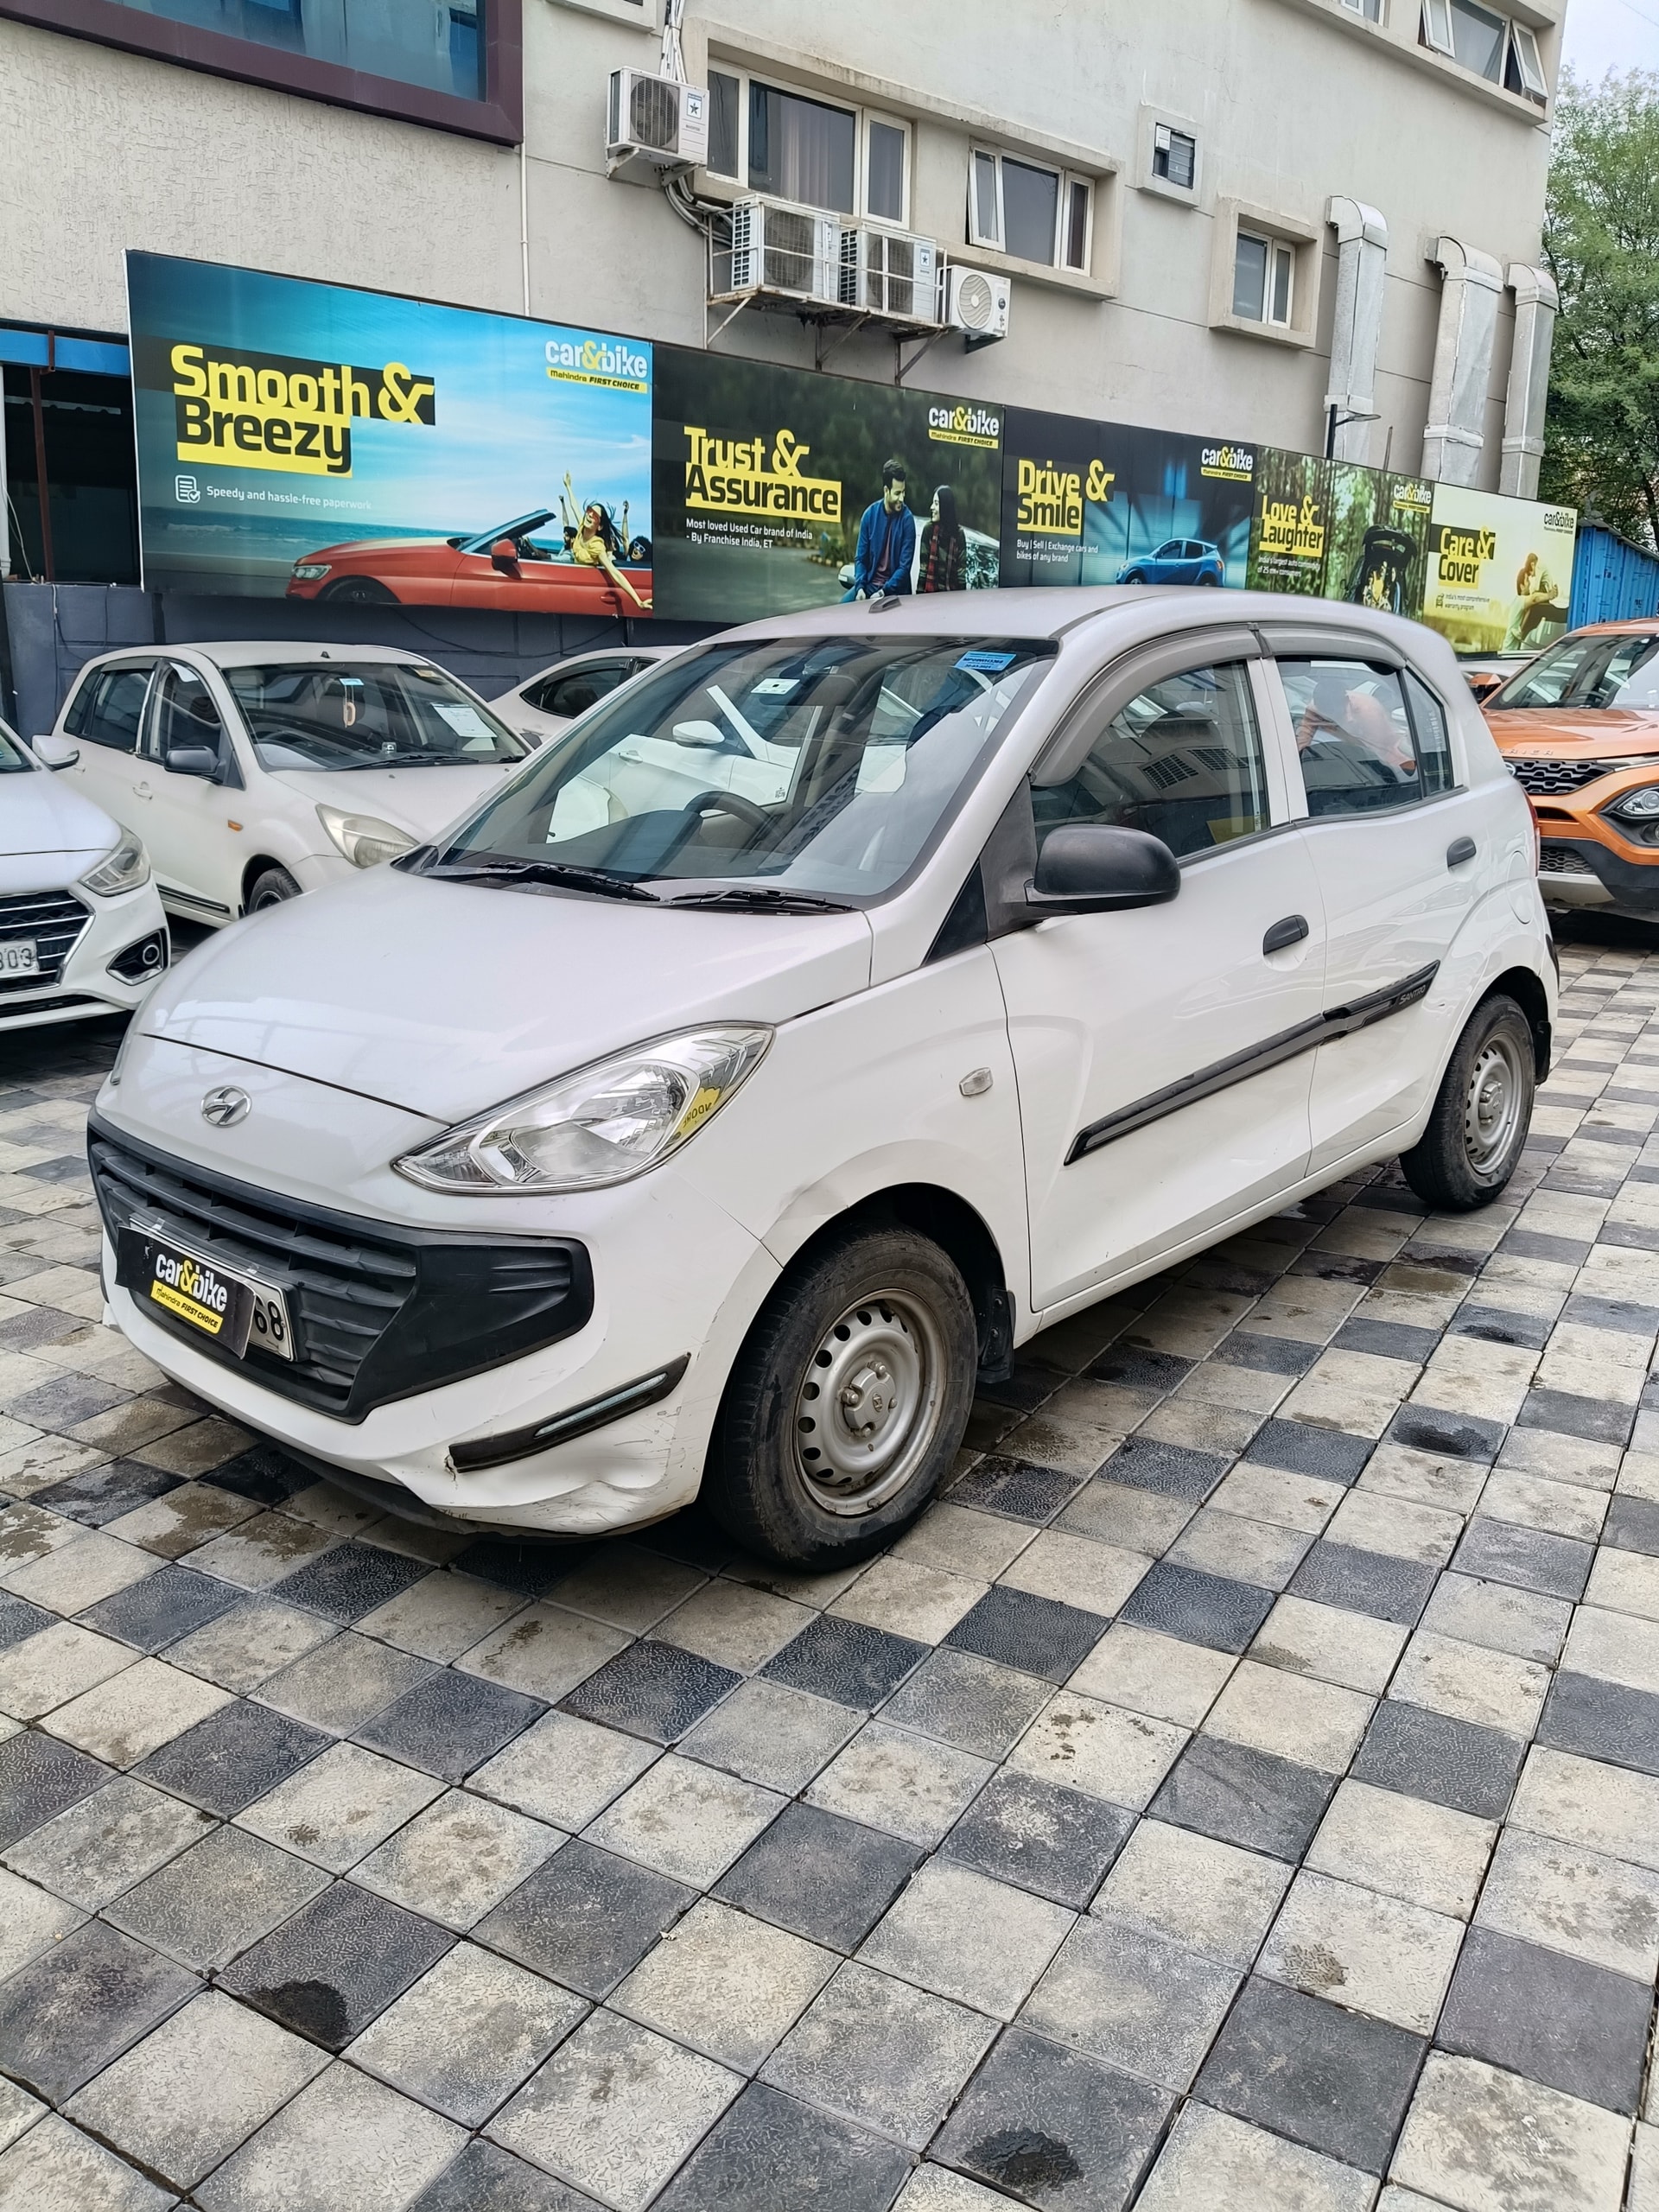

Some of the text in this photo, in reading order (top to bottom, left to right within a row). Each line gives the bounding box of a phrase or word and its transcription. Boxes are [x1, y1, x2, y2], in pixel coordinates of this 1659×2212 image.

[545, 340, 647, 378] car&bike
[170, 345, 435, 424] Smooth &
[550, 369, 640, 391] Mahindra FIRST CHOICE
[176, 396, 352, 474] Breezy
[928, 406, 1000, 436] car&bike
[683, 425, 810, 477] Trust &
[974, 438, 993, 447] CHOICE
[1201, 446, 1253, 471] car&bike
[686, 465, 838, 515] Assurance
[1018, 459, 1115, 502] Drive &
[207, 486, 372, 511] Speedy and hassle-free paperwork
[1017, 492, 1080, 530] Smile
[1262, 495, 1320, 526] Love &
[686, 518, 813, 540] Most loved Used Car brand of India
[691, 531, 702, 544] By
[703, 532, 741, 546] Franchise
[741, 537, 762, 550] India,
[763, 539, 773, 549] ET
[1262, 518, 1323, 552] Laughter
[1440, 525, 1496, 560] Care &
[1016, 550, 1069, 563] bikes of any brand
[1017, 538, 1029, 550] Buy
[1033, 540, 1044, 550] Sell
[1048, 541, 1075, 553] Exchange
[1075, 544, 1087, 553] cars
[1087, 544, 1099, 554] and
[1438, 554, 1479, 583] Cover
[1398, 984, 1426, 1006] SANTRO
[155, 1254, 227, 1313] car&bike
[181, 1302, 199, 1316] FIRST
[196, 1312, 219, 1328] CHOICE
[253, 1295, 284, 1341] 68
